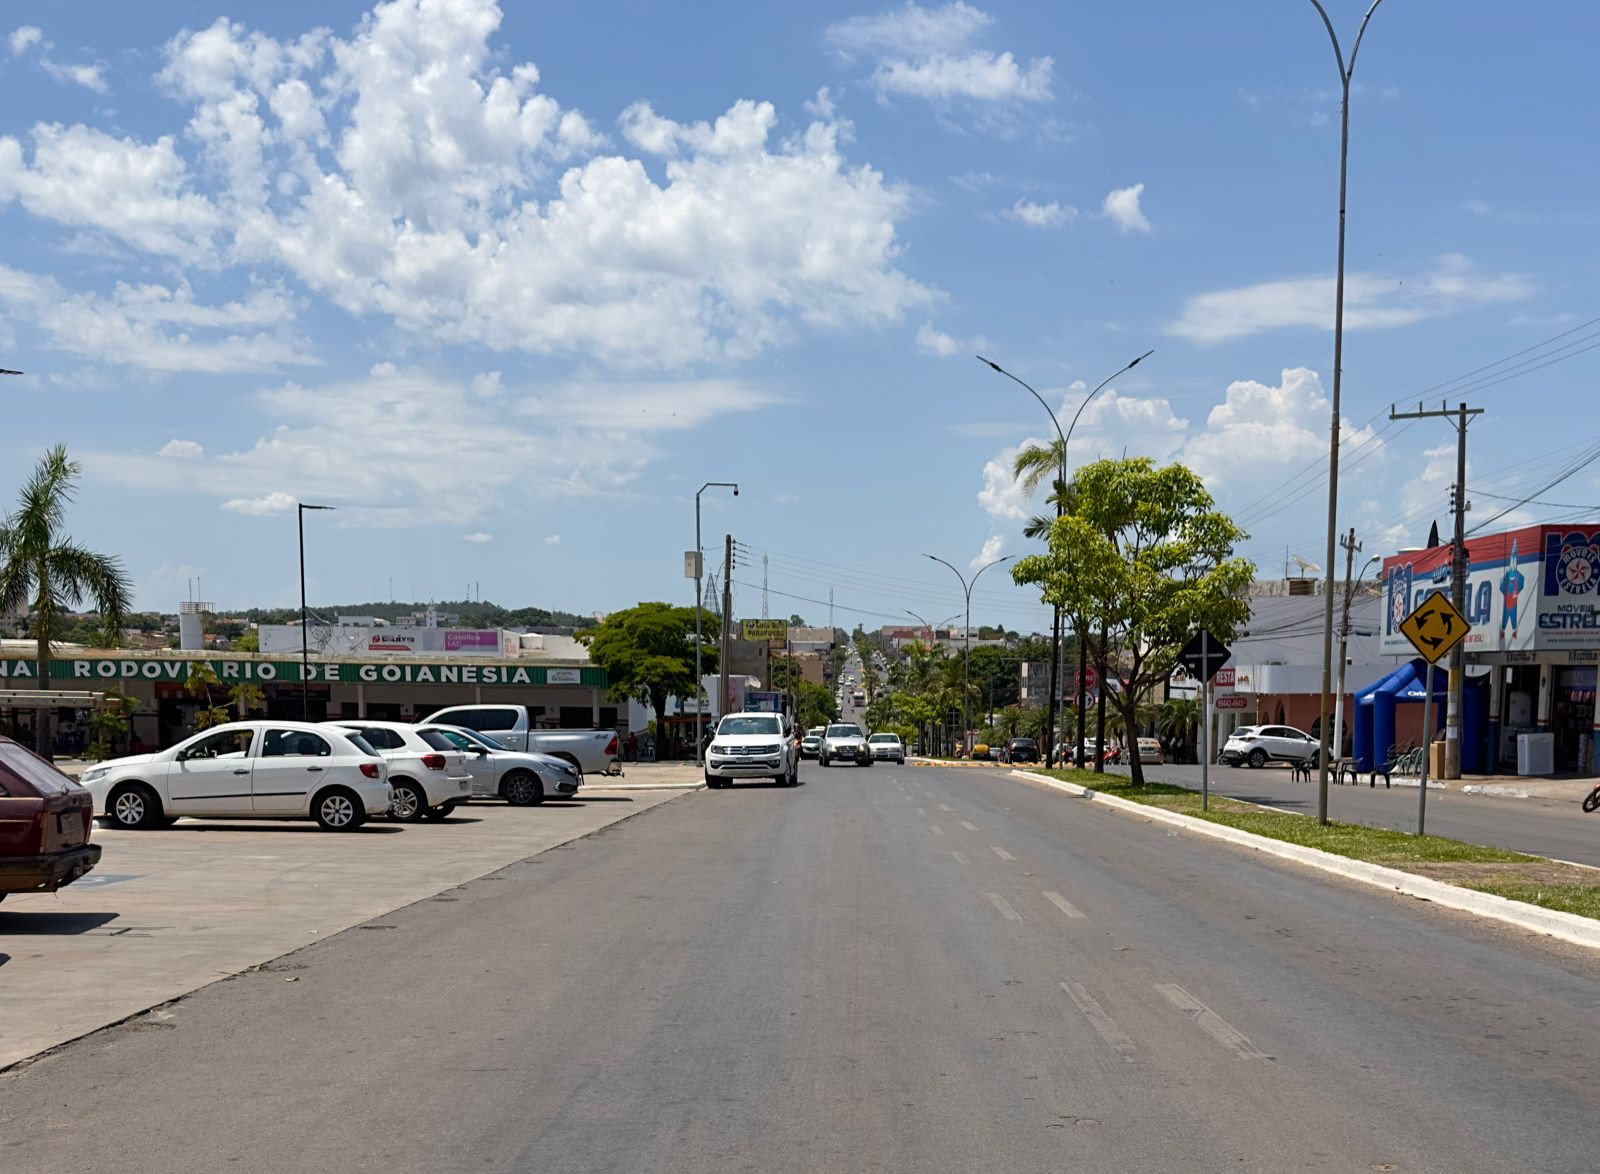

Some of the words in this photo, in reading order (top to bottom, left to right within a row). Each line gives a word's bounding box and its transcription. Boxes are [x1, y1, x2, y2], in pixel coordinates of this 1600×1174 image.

[1560, 577, 1598, 594] ESTRELA
[299, 663, 340, 681] DE
[359, 665, 531, 684] GOIANESIA
